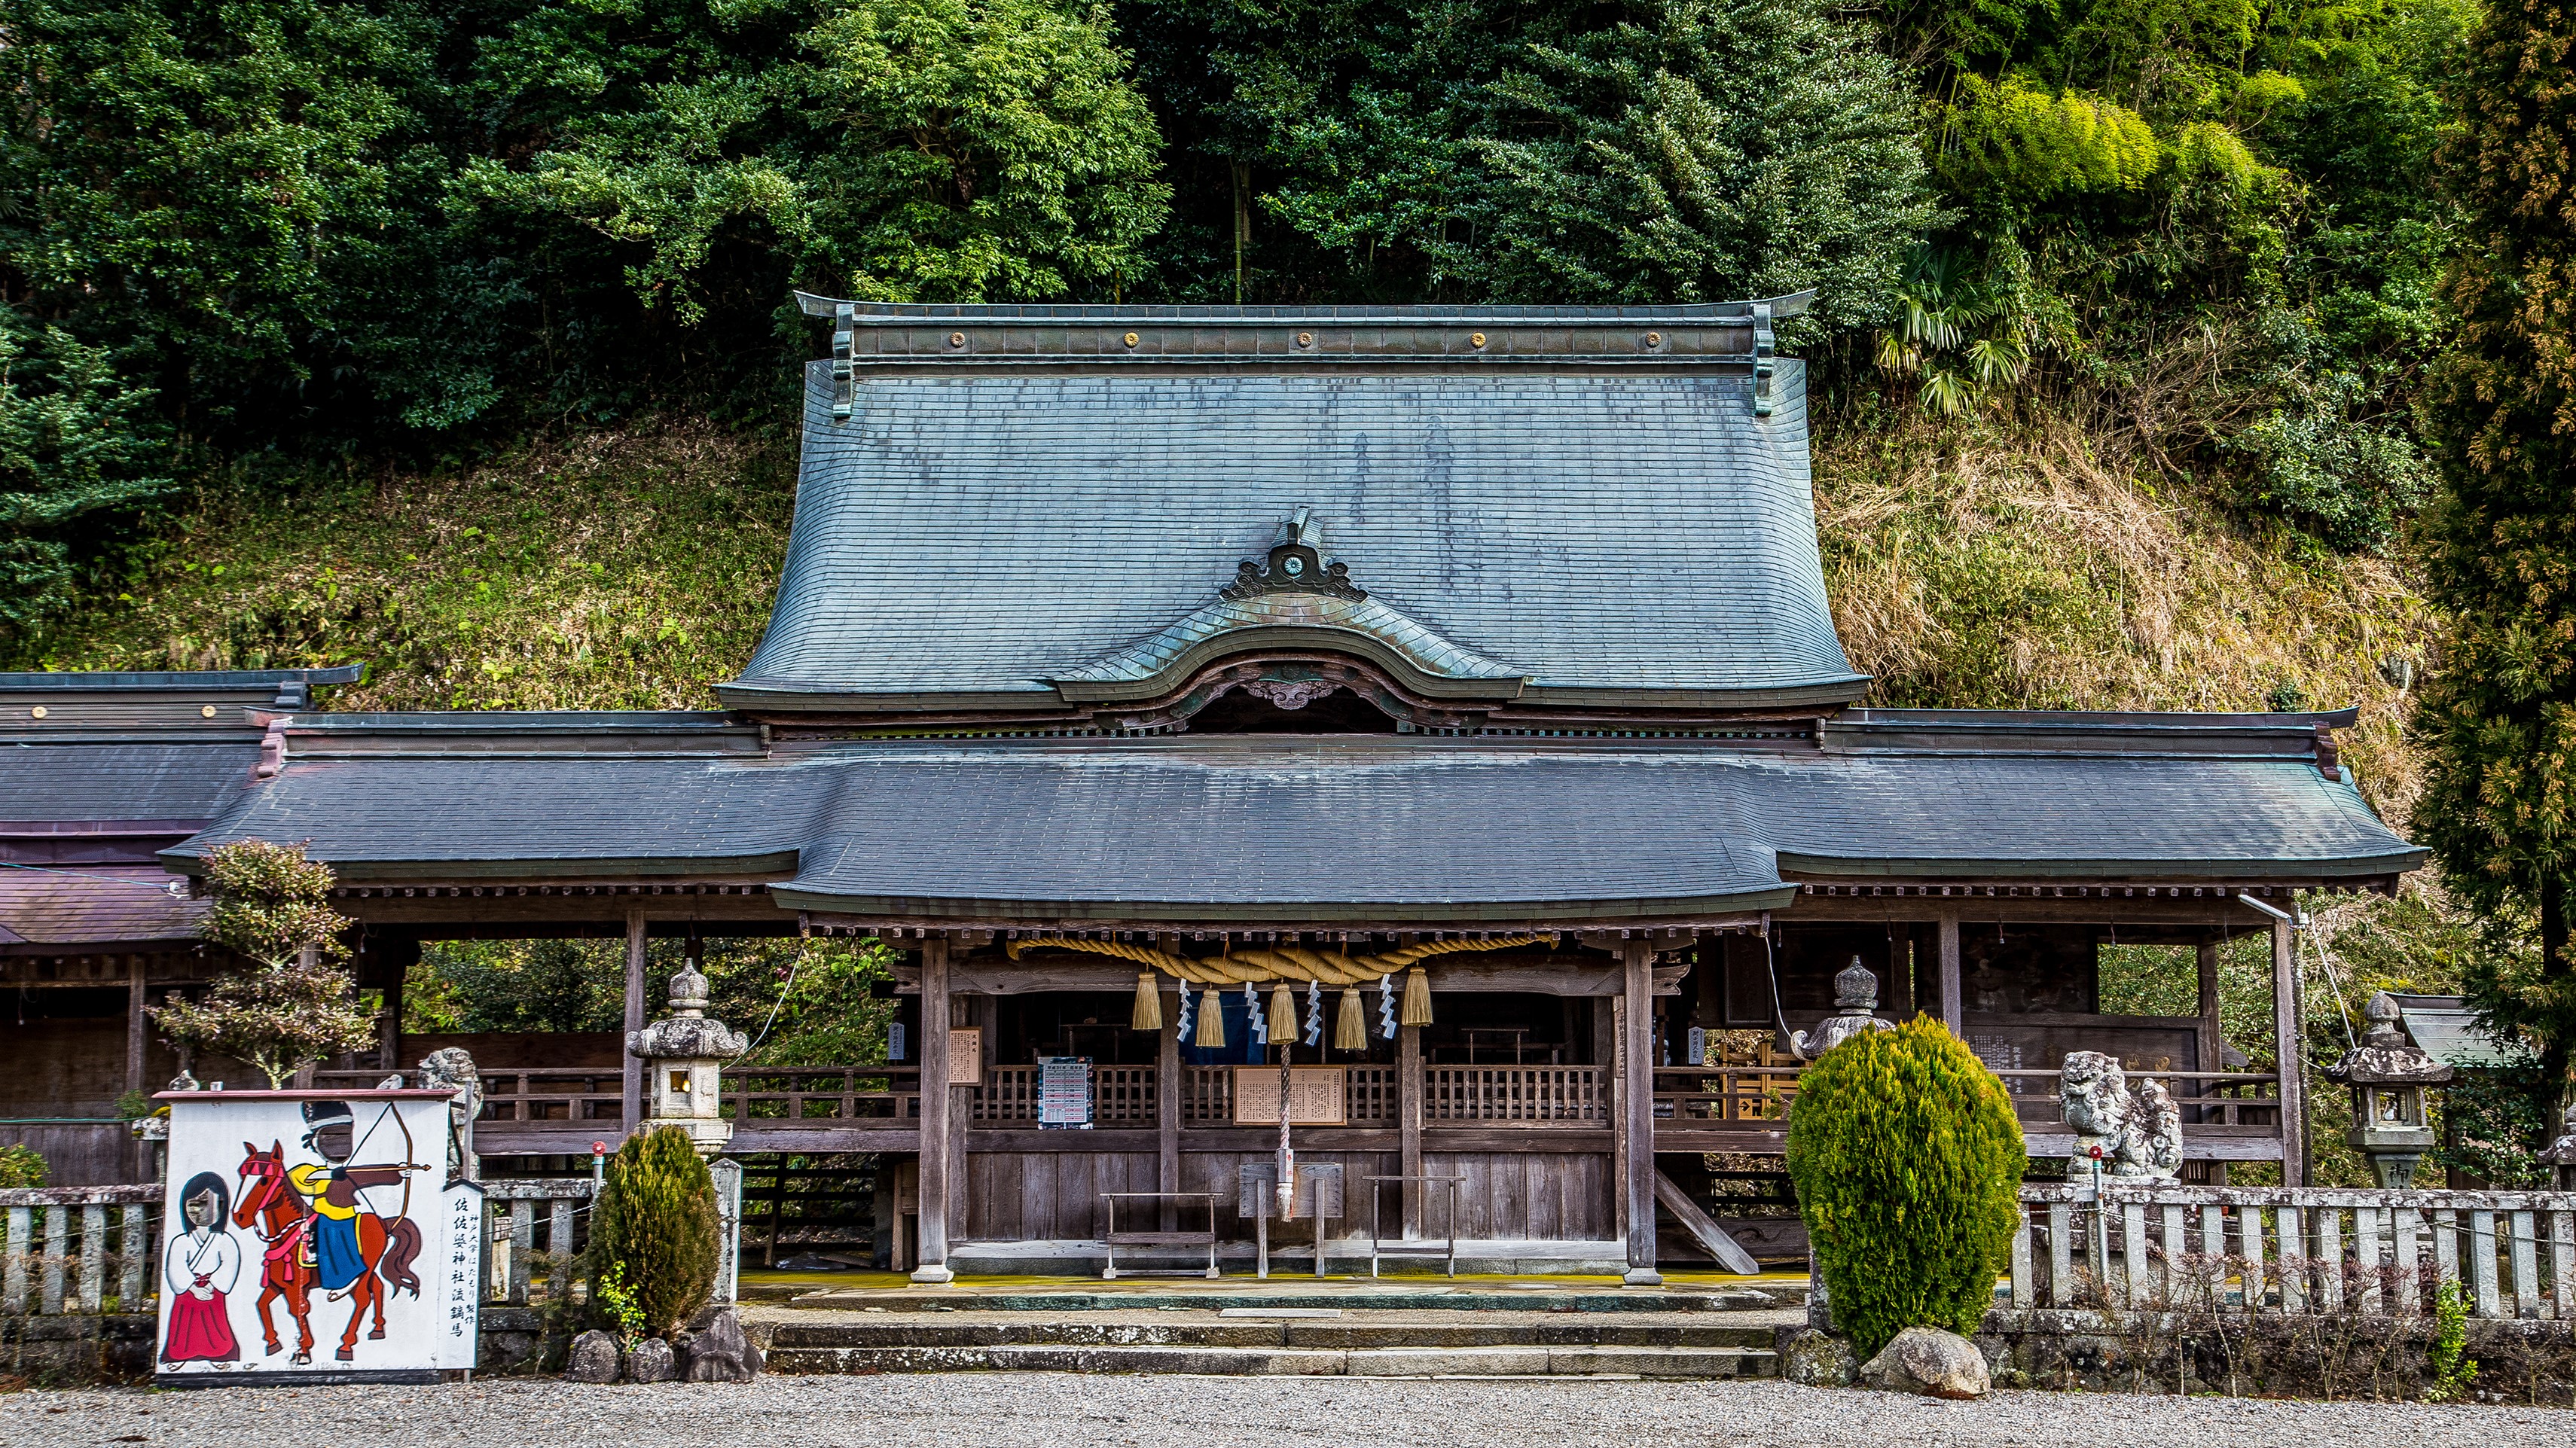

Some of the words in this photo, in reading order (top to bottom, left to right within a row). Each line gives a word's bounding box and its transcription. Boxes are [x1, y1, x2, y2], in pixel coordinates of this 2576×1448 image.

[2388, 1163, 2410, 1188] 御
[450, 1197, 469, 1337] 佐佐婆神社流鏑馬
